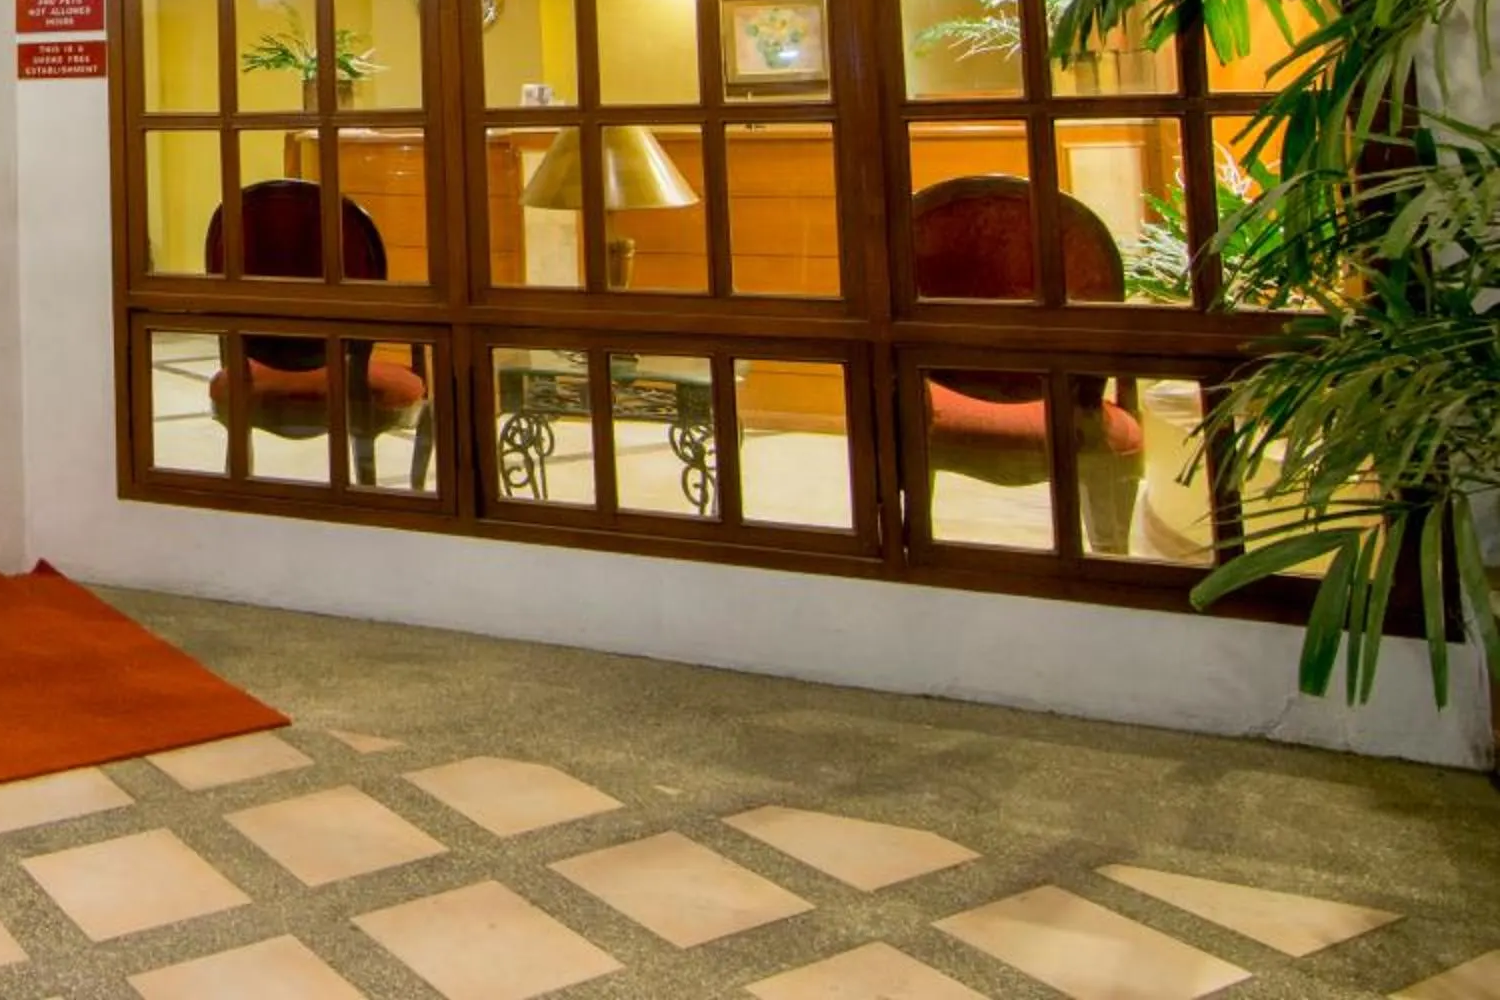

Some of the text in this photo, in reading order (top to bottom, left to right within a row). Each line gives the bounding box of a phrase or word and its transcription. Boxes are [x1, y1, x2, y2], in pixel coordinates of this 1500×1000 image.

[50, 6, 92, 16] ALLOWED
[39, 45, 60, 53] THIS
[63, 45, 73, 53] IS
[25, 65, 98, 75] ESTABLISHMENT
